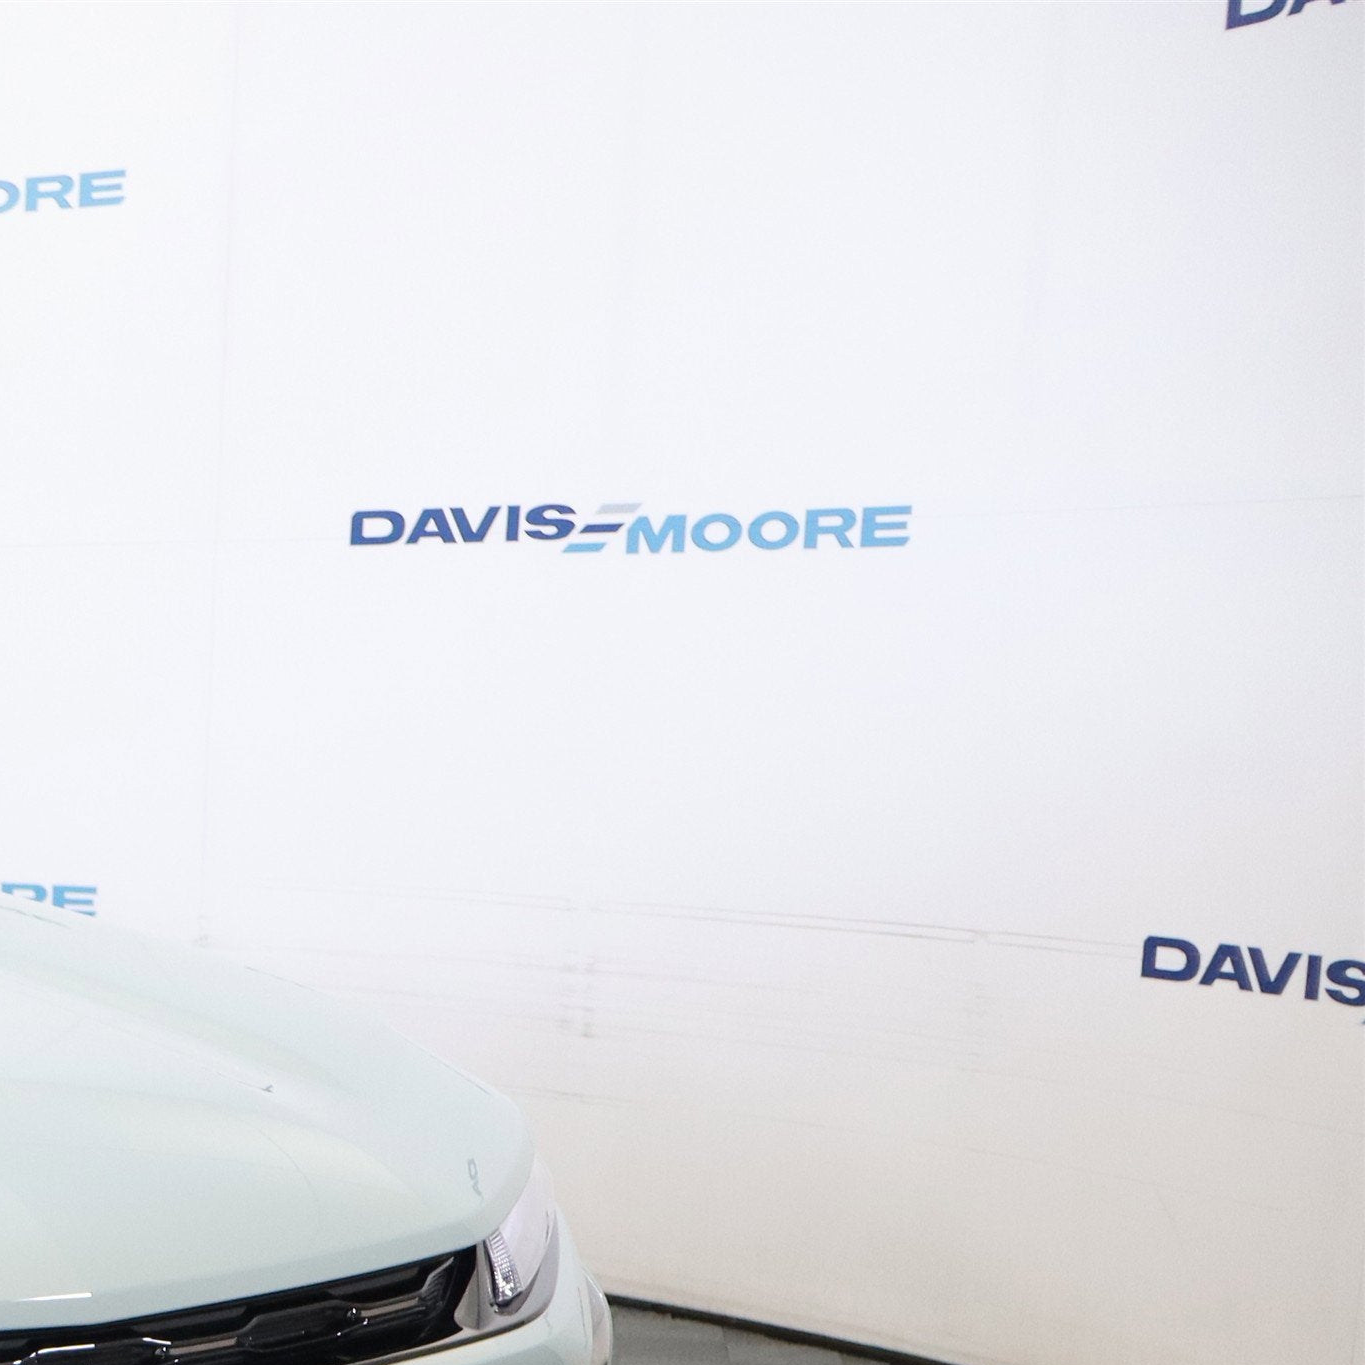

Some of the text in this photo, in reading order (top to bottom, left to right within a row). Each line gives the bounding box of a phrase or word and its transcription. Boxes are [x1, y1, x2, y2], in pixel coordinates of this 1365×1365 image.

[348, 503, 913, 555] DAVIS MOORE
[1139, 934, 1365, 1008] DAVIS
